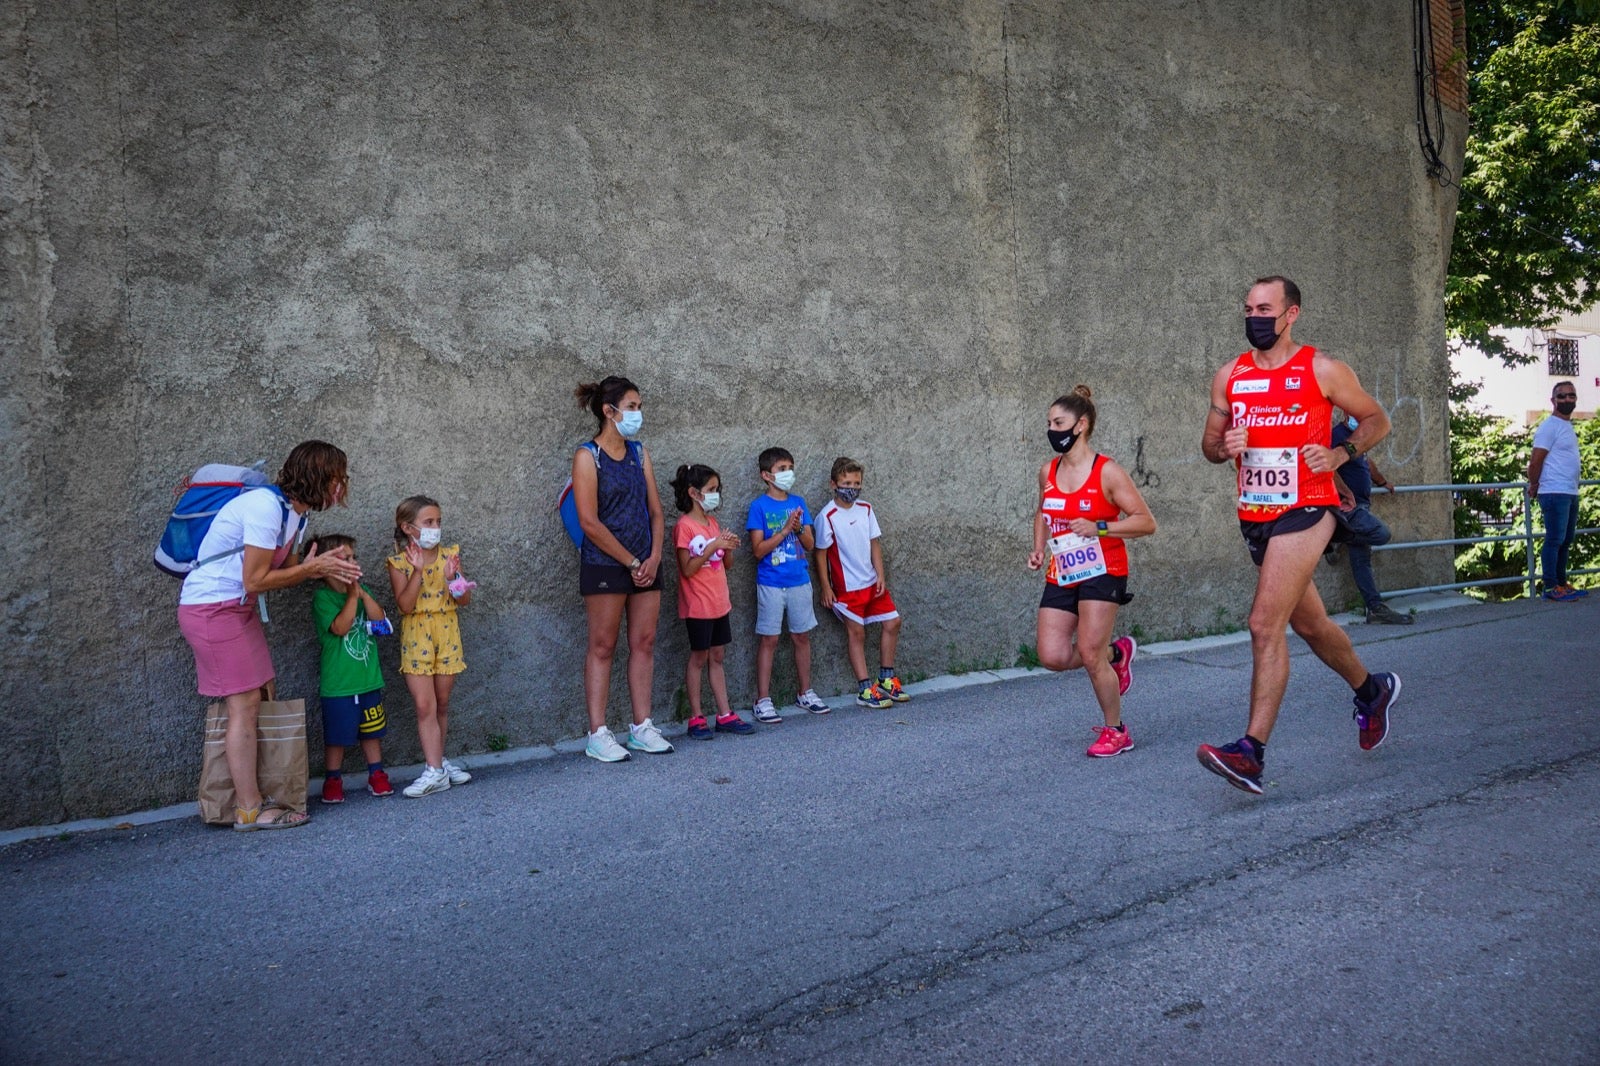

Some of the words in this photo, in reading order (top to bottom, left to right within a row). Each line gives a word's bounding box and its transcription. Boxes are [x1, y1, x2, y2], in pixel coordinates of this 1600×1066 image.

[1231, 401, 1308, 428] Polisalud
[1245, 469, 1290, 487] 2103
[1252, 494, 1273, 502] RAFAEL
[1060, 547, 1097, 569] 2096
[363, 702, 384, 721] 199
